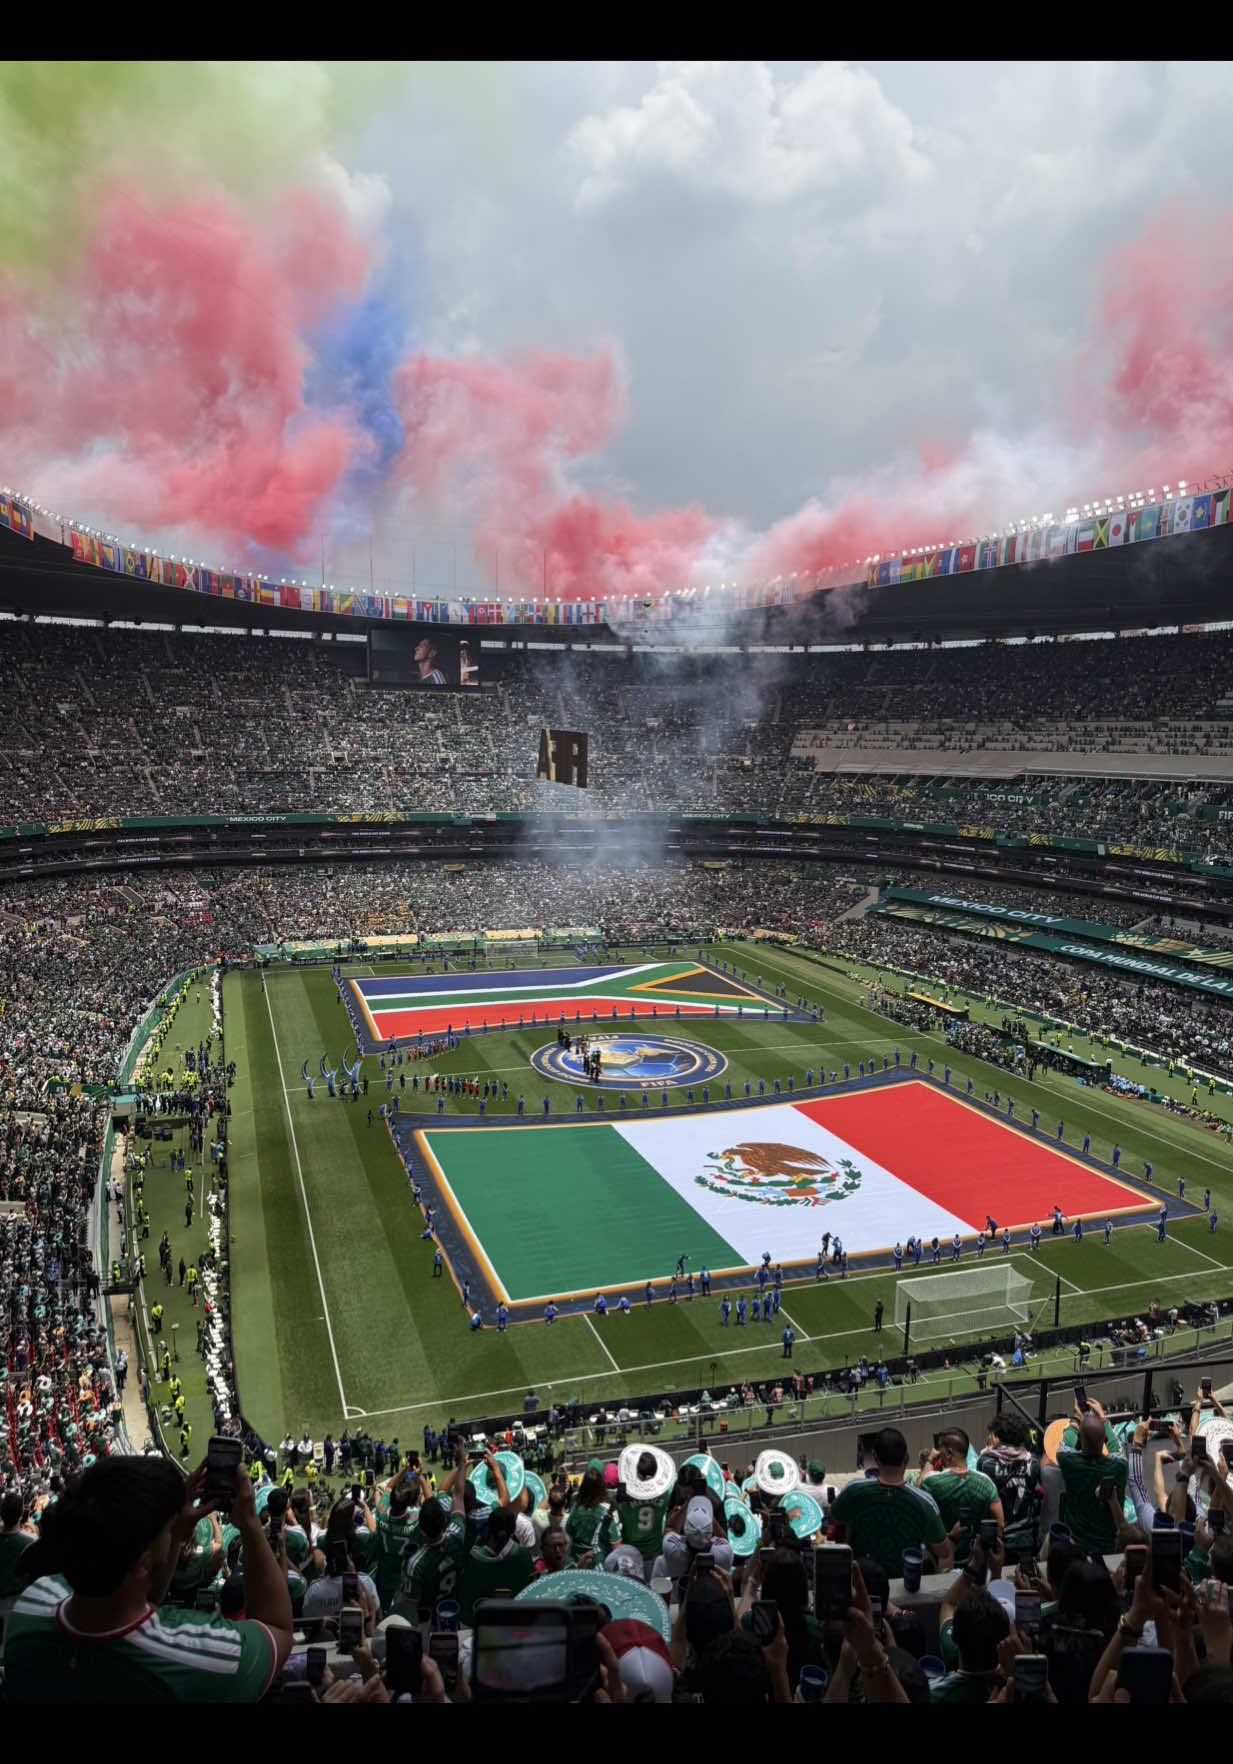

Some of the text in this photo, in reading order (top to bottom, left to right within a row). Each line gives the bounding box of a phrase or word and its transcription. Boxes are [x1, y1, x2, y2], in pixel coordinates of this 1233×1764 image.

[1218, 810, 1233, 820] FIF
[928, 895, 1065, 923] MEXICO CITY
[1060, 945, 1102, 959] COPA
[1102, 954, 1178, 977] MUNDIAL
[1176, 972, 1204, 983] DE
[1200, 978, 1228, 990] LA
[637, 1506, 653, 1530] 9
